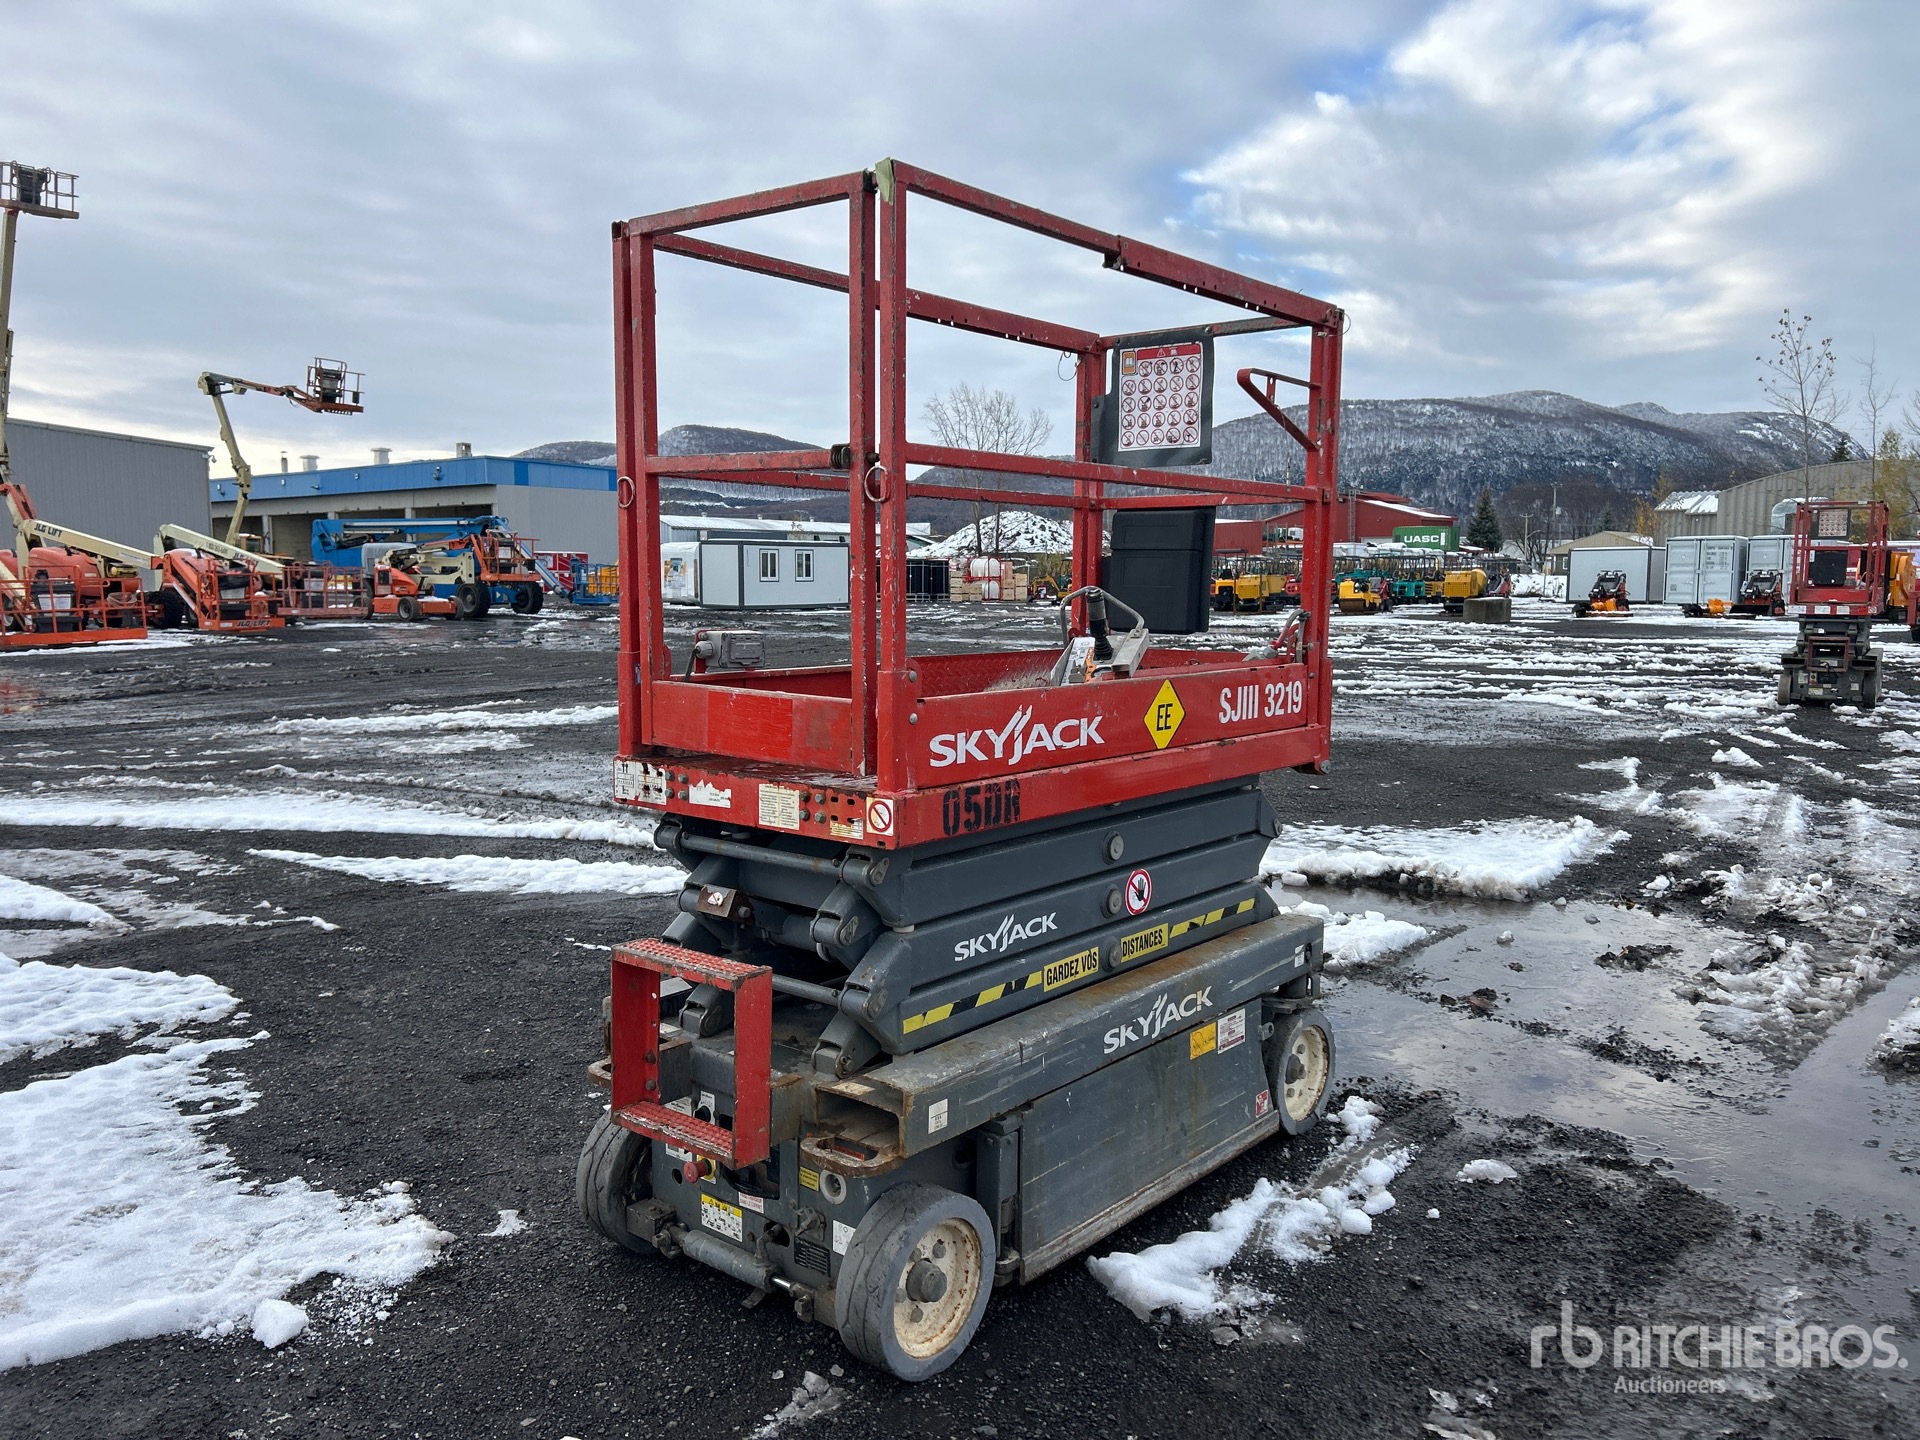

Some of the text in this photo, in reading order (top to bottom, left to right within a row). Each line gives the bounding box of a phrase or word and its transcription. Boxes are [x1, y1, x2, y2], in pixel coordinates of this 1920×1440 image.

[34, 523, 62, 537] JLG LIFT
[1404, 535, 1439, 543] UASC
[1219, 680, 1302, 724] SJIII 3219
[1156, 703, 1173, 731] EE
[929, 704, 1105, 767] SKYJACK
[954, 912, 1058, 962] SKYJACK
[1121, 928, 1164, 957] DISTANCES
[1046, 959, 1080, 986] GARDEZ
[1103, 985, 1214, 1055] SKYJACK
